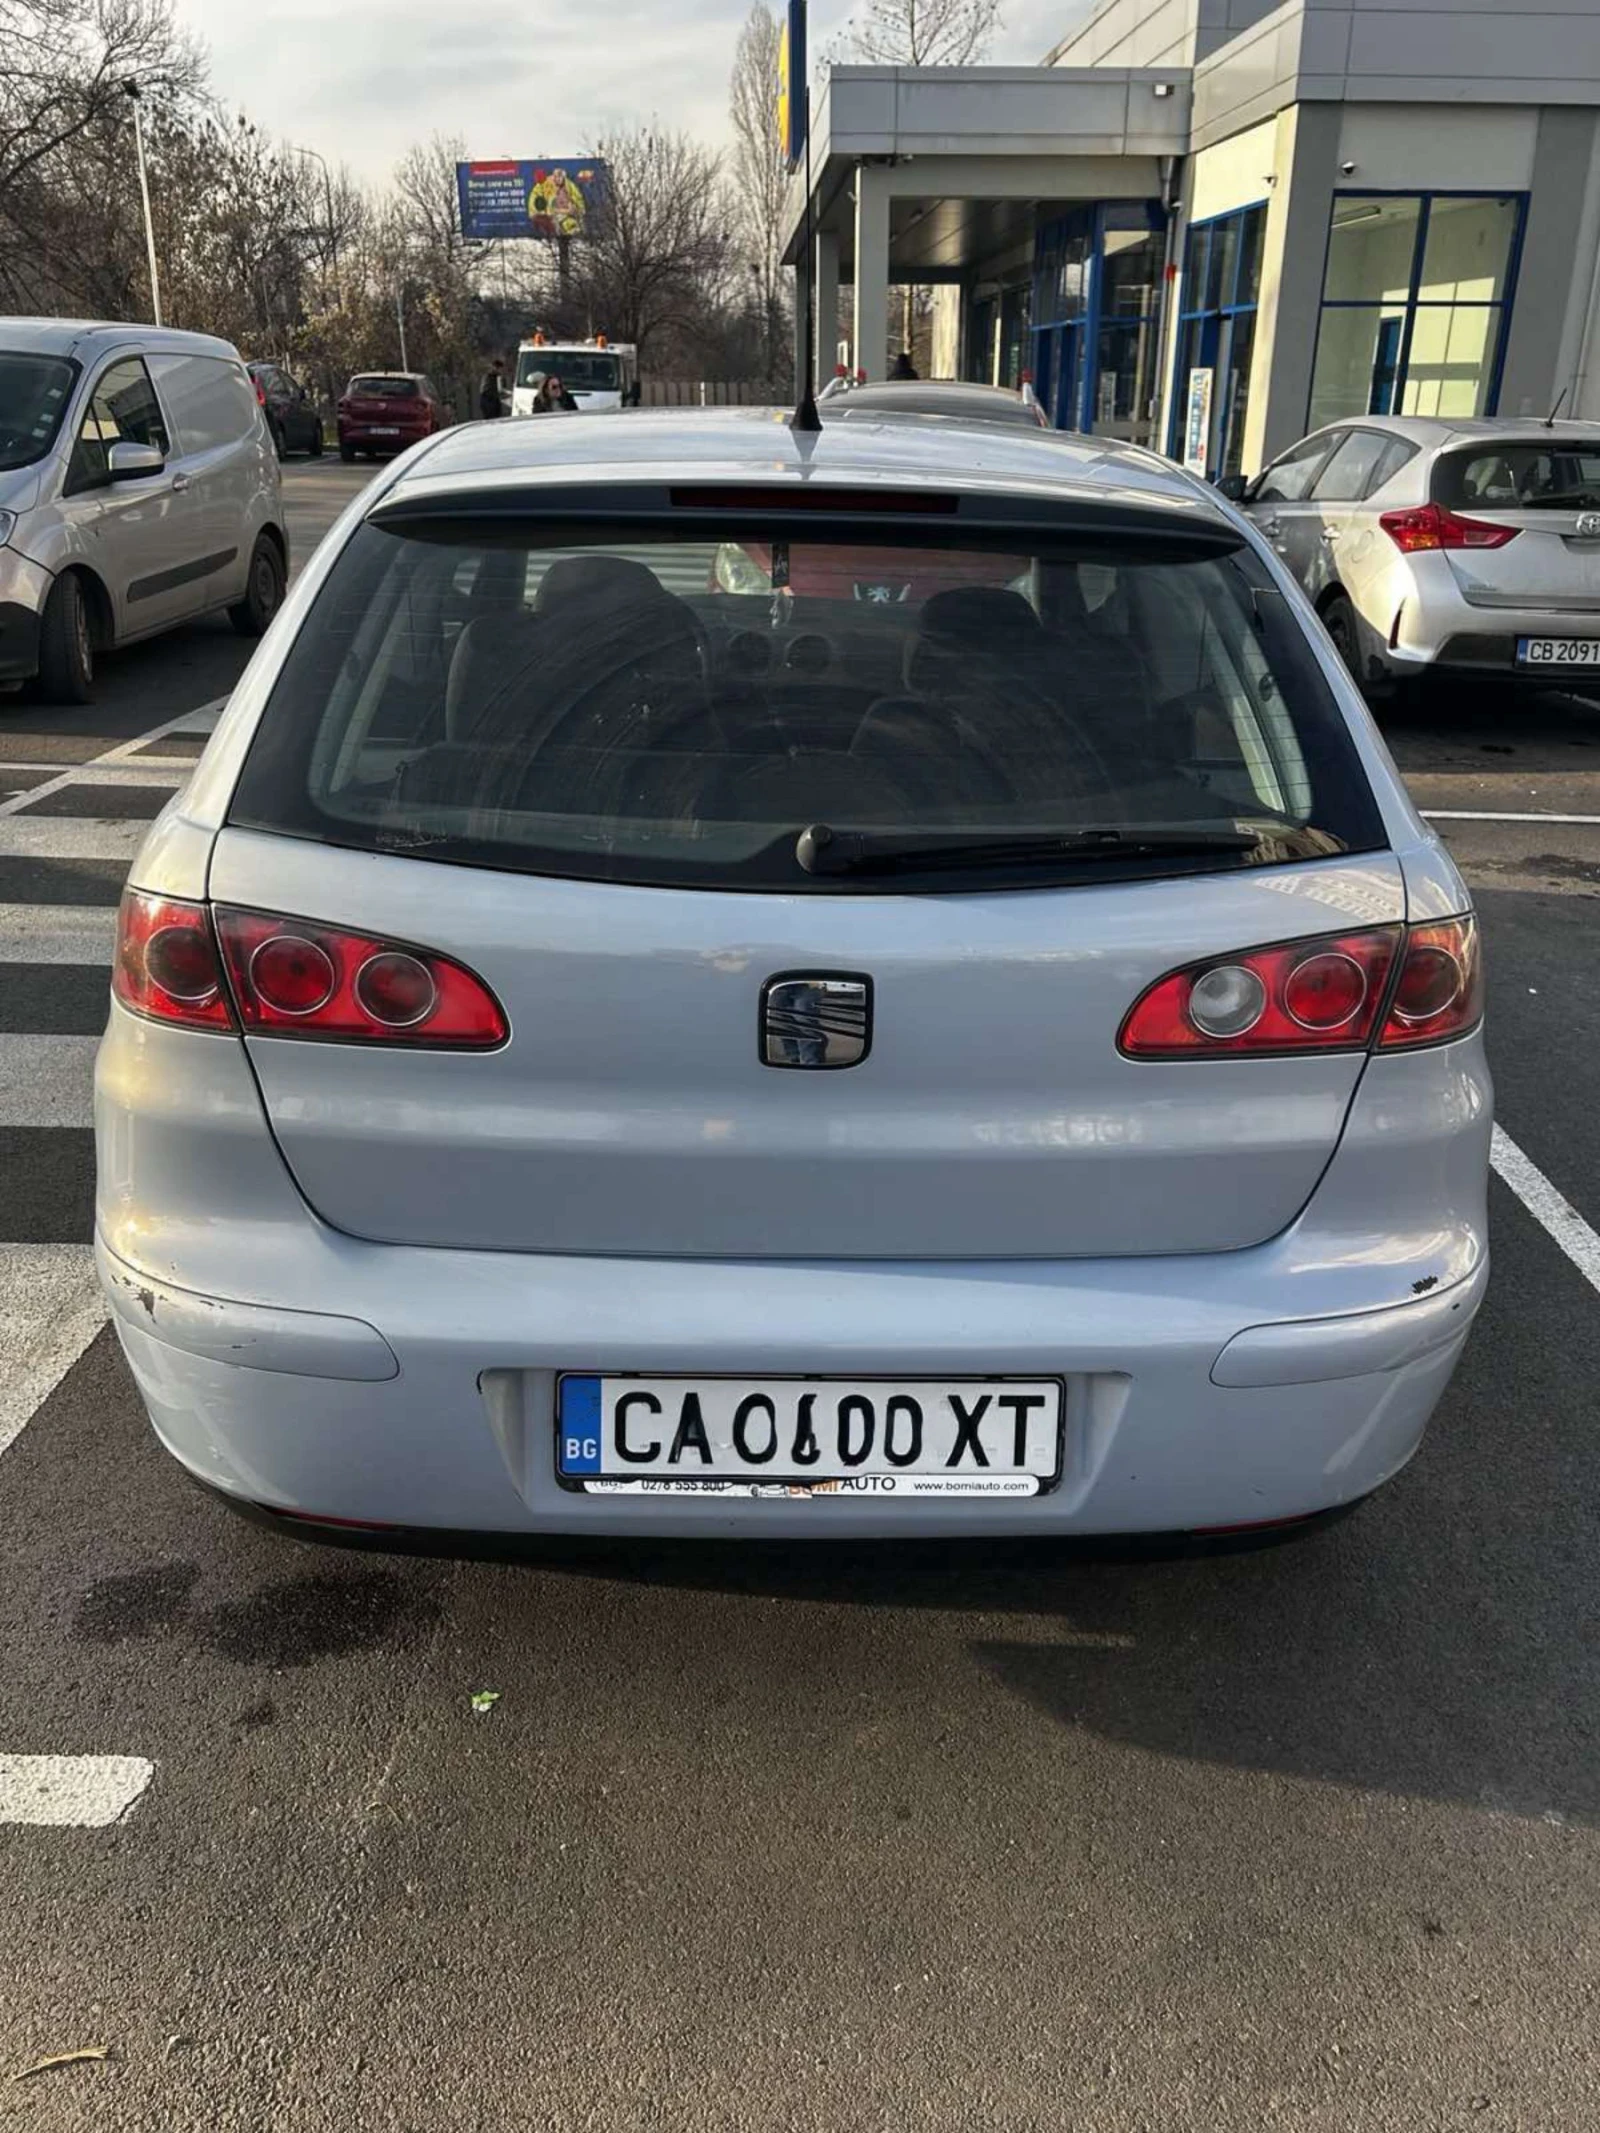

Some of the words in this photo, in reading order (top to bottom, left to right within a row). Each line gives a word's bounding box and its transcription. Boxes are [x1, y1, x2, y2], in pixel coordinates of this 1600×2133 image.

[1530, 642, 1553, 661] CB
[1556, 643, 1599, 661] 2091
[614, 1391, 713, 1464] CA
[945, 1395, 1046, 1467] XT
[566, 1438, 597, 1459] BG
[841, 1477, 896, 1491] AUTO
[913, 1482, 1029, 1491] www.bomiauto.com
